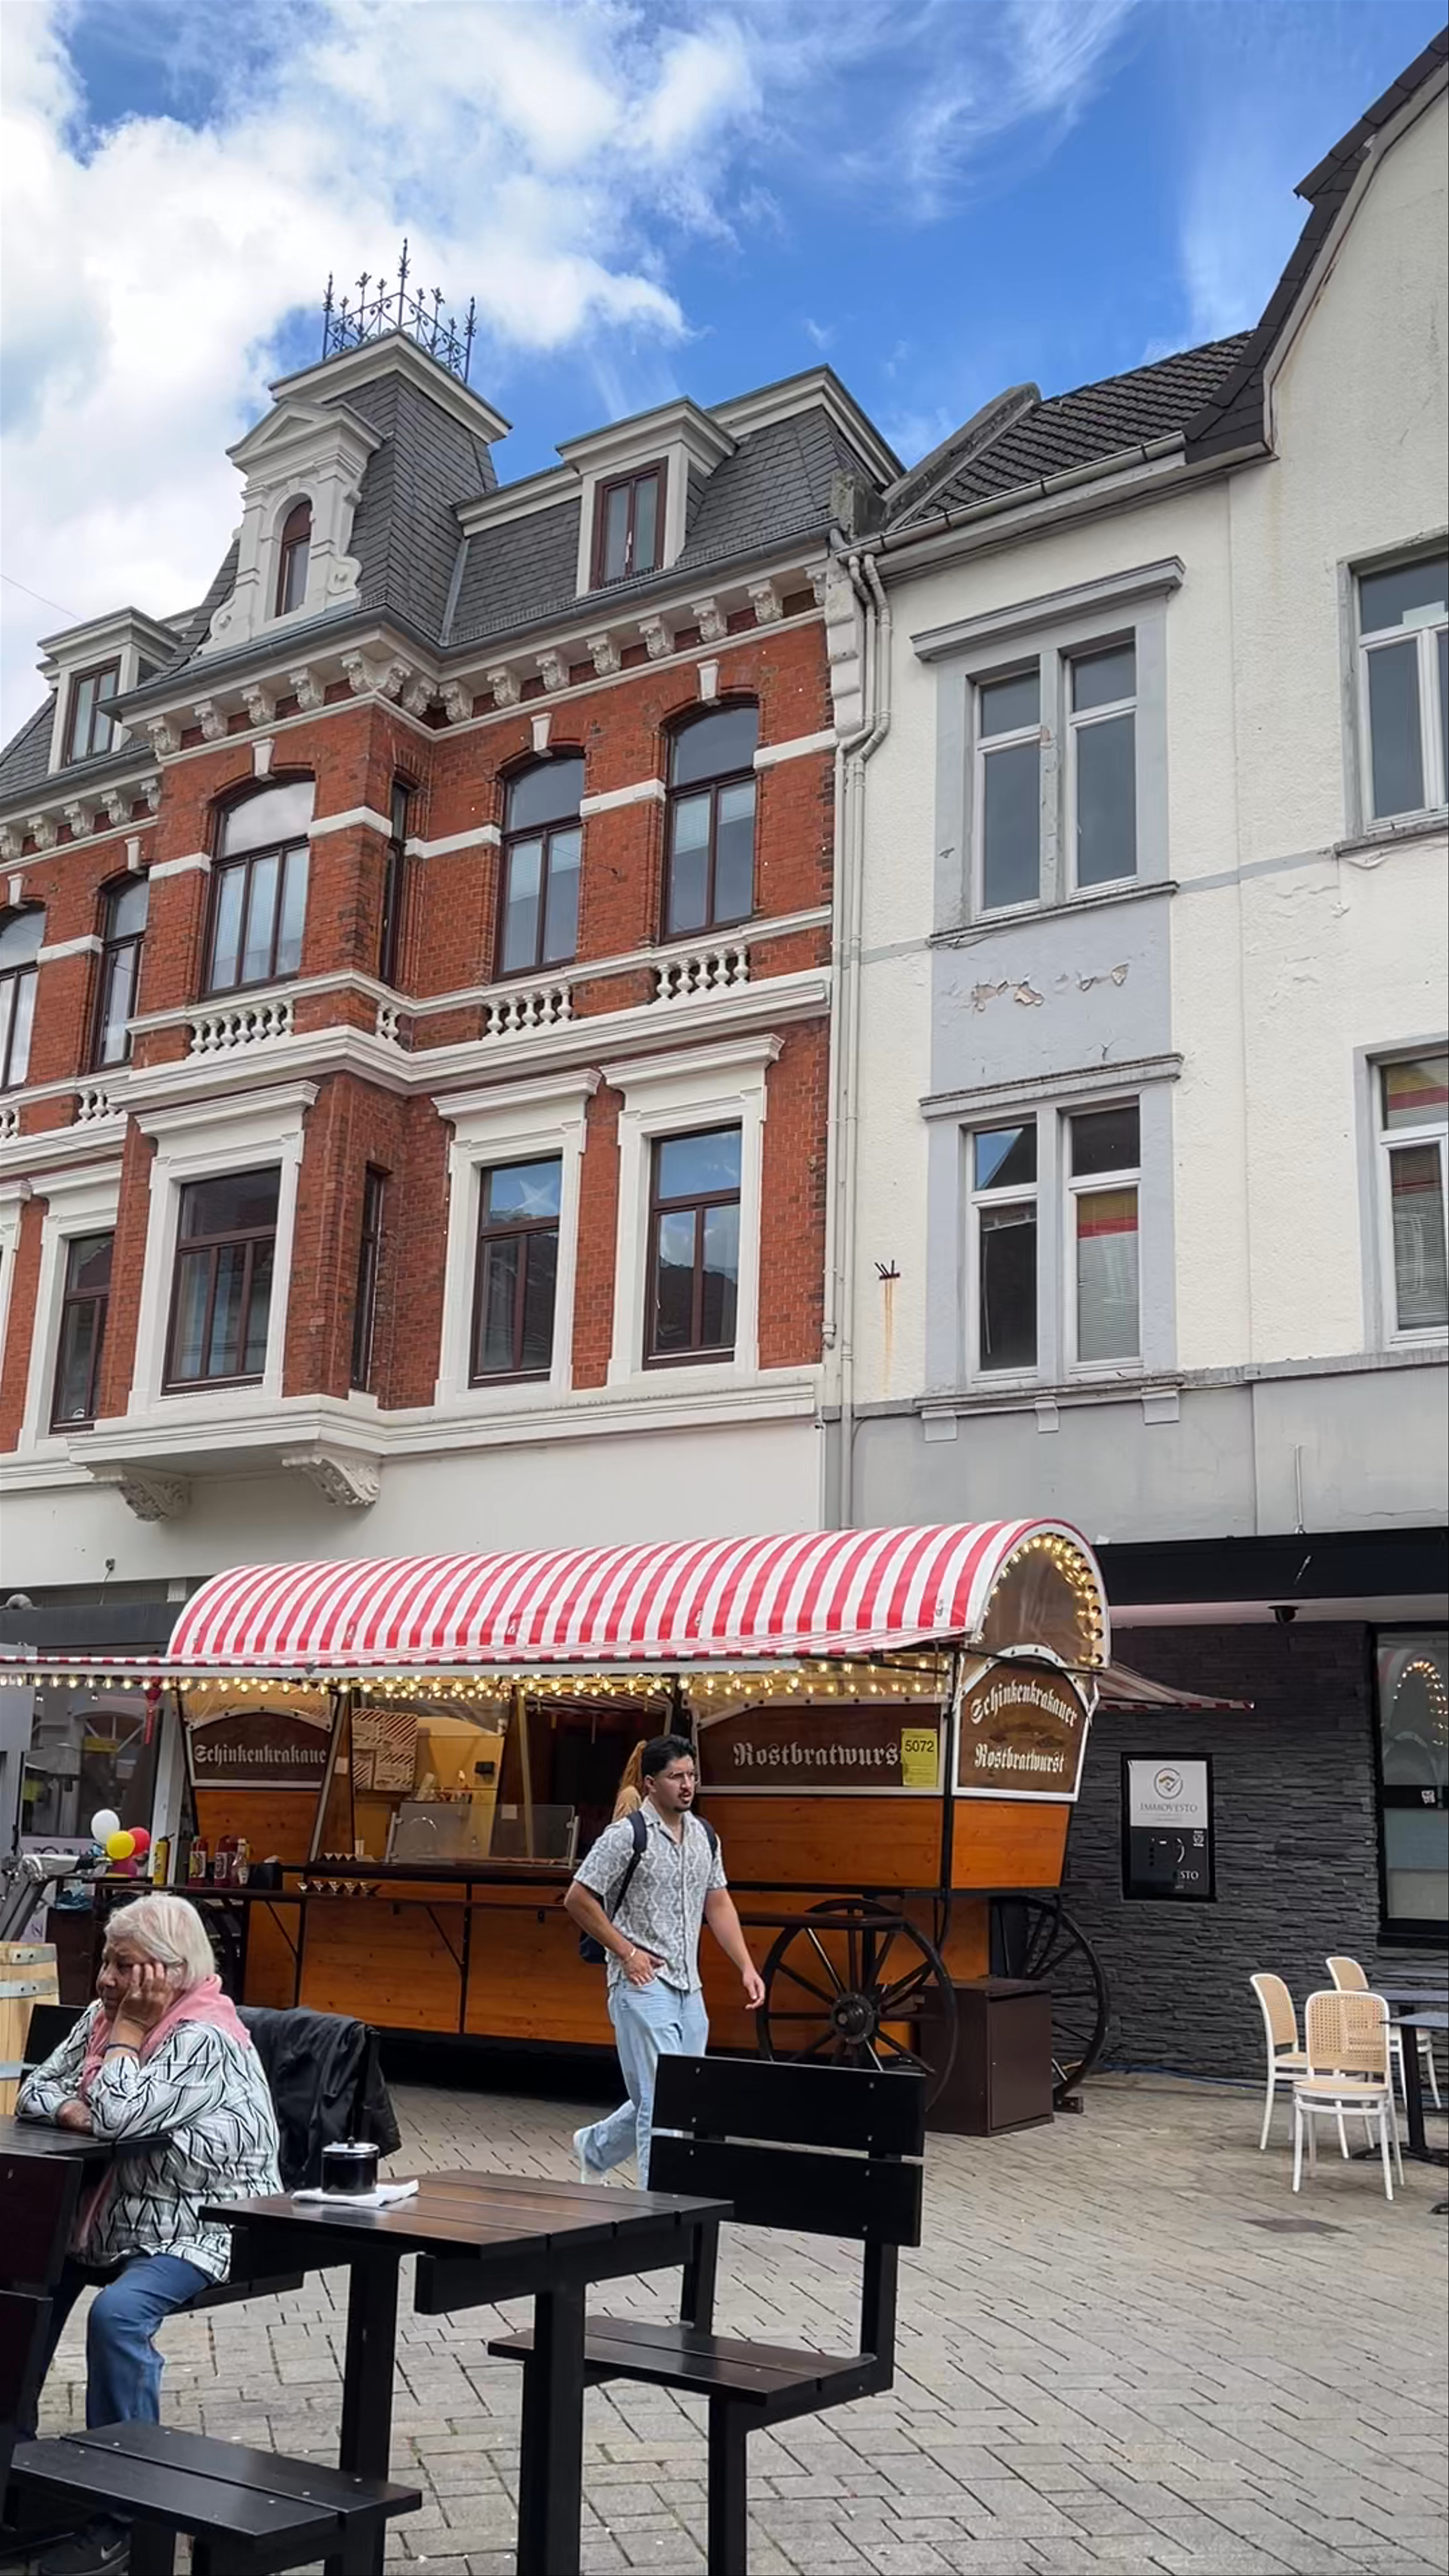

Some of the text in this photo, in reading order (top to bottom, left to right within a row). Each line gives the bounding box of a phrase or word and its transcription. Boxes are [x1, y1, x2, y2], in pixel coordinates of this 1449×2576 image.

[971, 1680, 1077, 1727] Schinkenkrakauer
[194, 1744, 326, 1767] Schinkenkrakaue
[734, 1742, 901, 1766] Rostbratwurs
[905, 1740, 934, 1752] 5072
[975, 1744, 1064, 1772] Rostbratwurst
